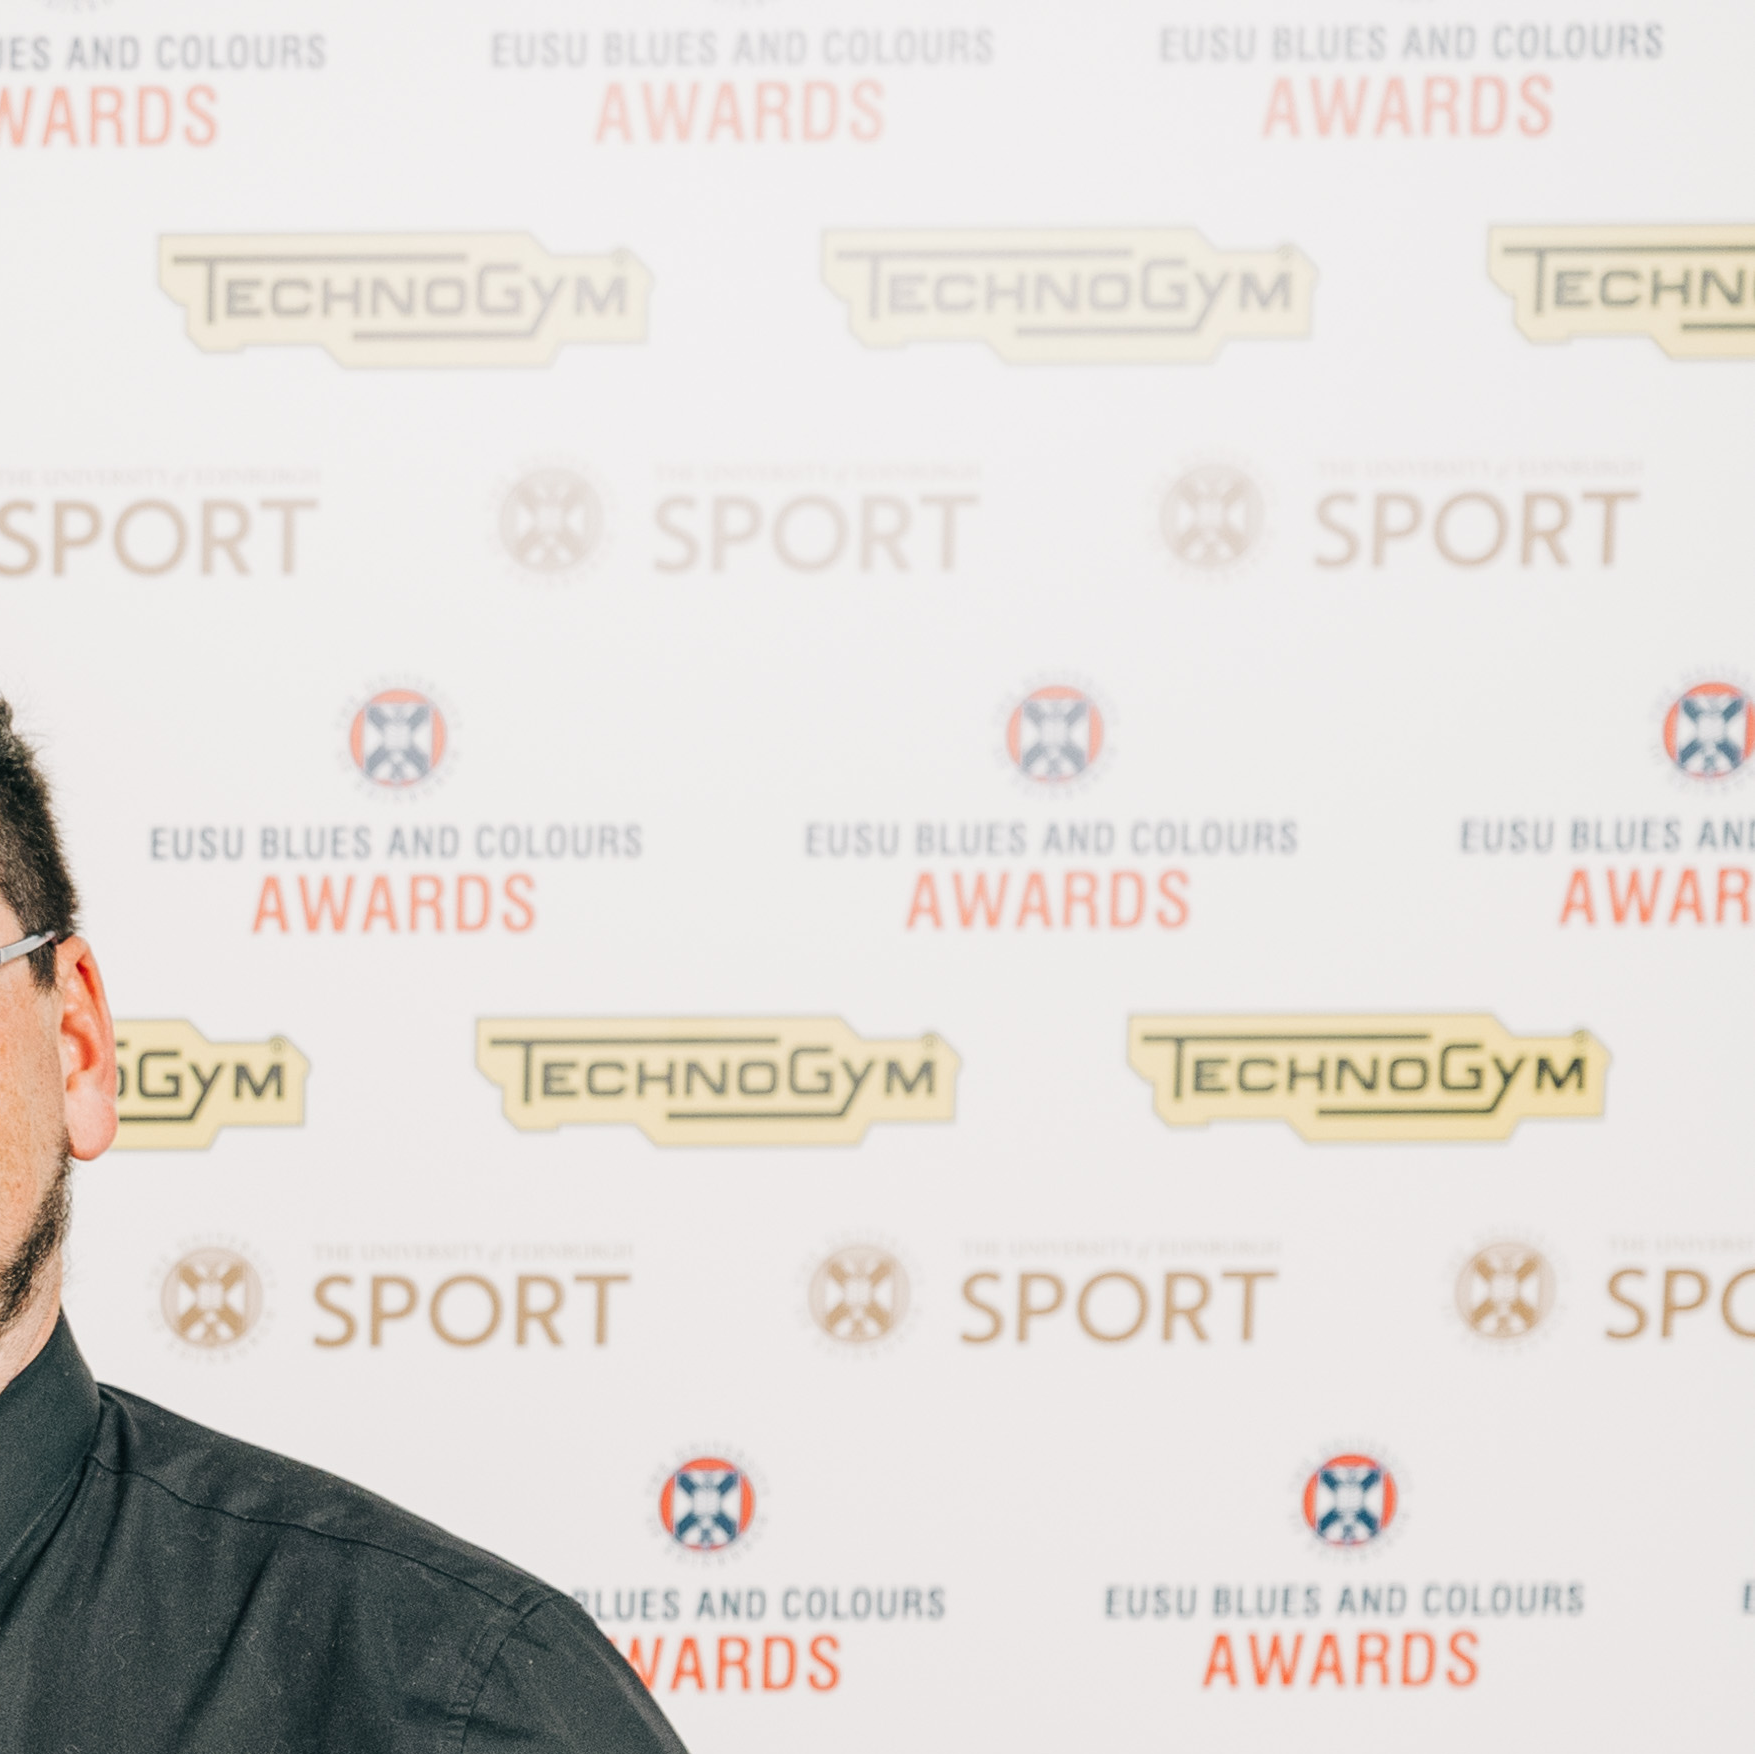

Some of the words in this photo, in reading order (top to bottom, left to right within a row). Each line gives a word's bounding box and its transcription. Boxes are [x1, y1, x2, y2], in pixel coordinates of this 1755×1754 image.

[1160, 26, 1256, 62] EUSU
[1271, 25, 1387, 62] BLUES
[1401, 24, 1478, 61] AND
[1491, 21, 1665, 62] COLOURS
[594, 78, 884, 143] AWARDS
[1262, 72, 1553, 139] AWARDS
[1315, 489, 1641, 569] SPORT
[148, 825, 245, 863] EUSU
[259, 824, 372, 861] BLUES
[386, 824, 461, 860] AND
[474, 824, 643, 860] COLOURS
[252, 872, 536, 934] AWARDS
[906, 868, 1190, 930] AWARDS
[312, 1273, 631, 1350] SPORT
[960, 1269, 1278, 1346] SPORT
[1104, 1585, 1198, 1619] EUSU
[1211, 1584, 1322, 1619] BLUES
[1335, 1583, 1408, 1617] AND
[1421, 1582, 1585, 1617] COLOURS
[1203, 1630, 1479, 1688] AWARDS
